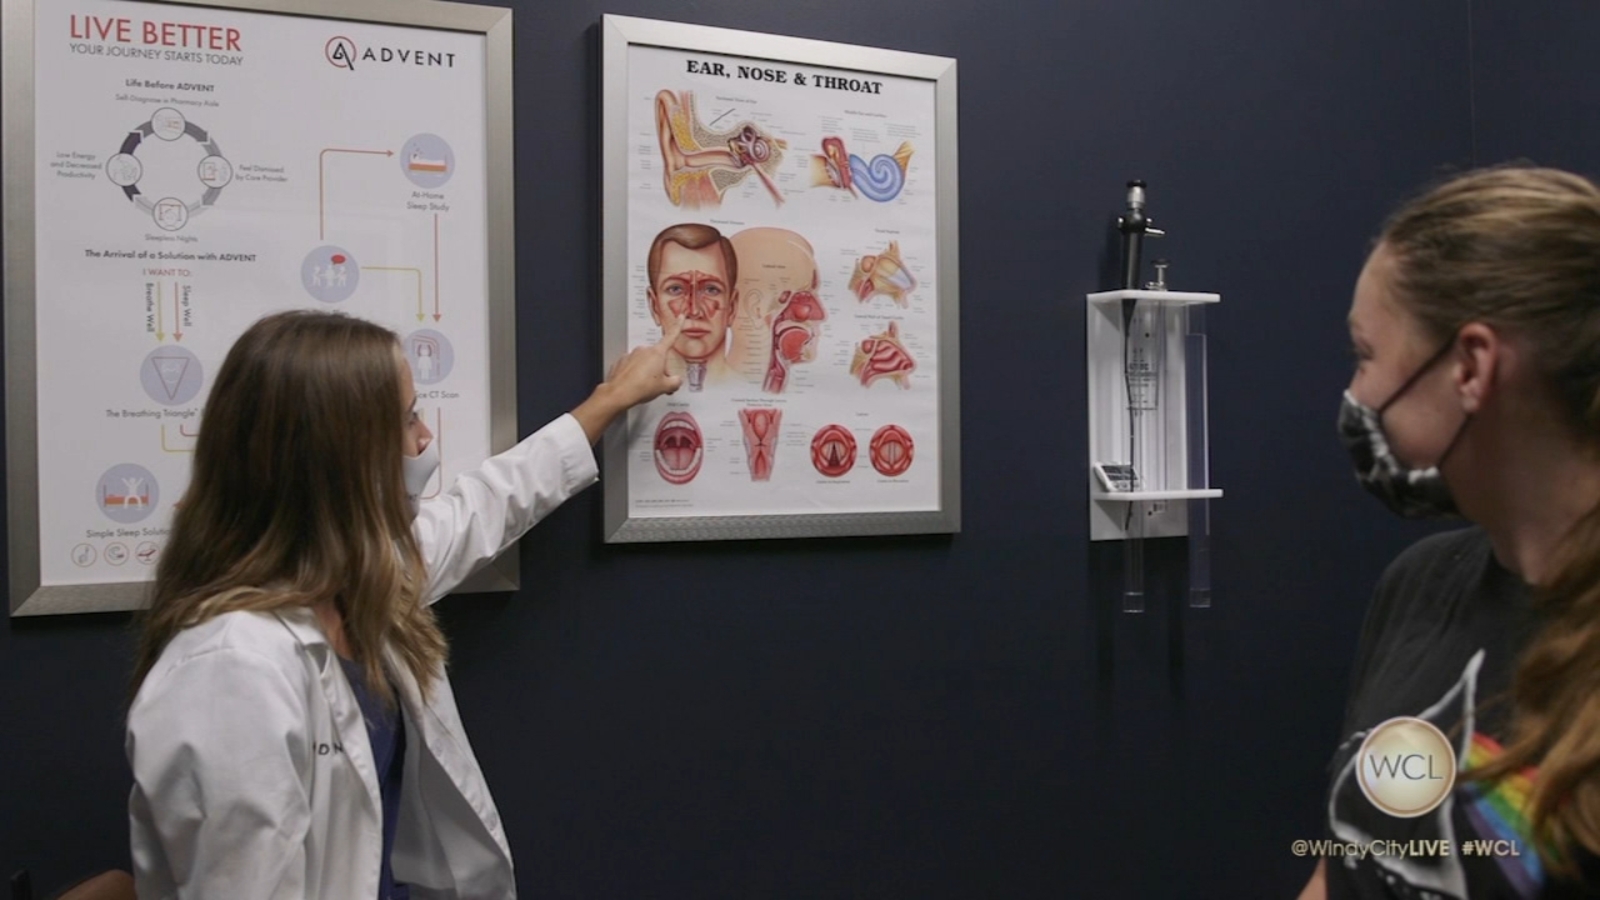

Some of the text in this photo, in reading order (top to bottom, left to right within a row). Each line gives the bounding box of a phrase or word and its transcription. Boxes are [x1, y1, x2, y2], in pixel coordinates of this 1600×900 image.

[70, 14, 242, 52] LIVE BETTER
[69, 43, 244, 66] YOUR JOURNEY STARTS TODAY
[362, 46, 456, 68] ADVENT
[125, 79, 215, 92] Life Before ADVENT
[686, 59, 883, 95] EAR, NOSE & THROAT
[85, 250, 101, 258] The
[103, 250, 136, 259] Arrival
[137, 250, 148, 259] of
[157, 251, 196, 260] Solution
[197, 252, 217, 261] with
[219, 253, 257, 262] ADVENT
[148, 268, 175, 276] WANT
[145, 282, 156, 332] Breathe Well
[182, 285, 192, 327] Sleep Well
[106, 409, 120, 417] The
[121, 409, 162, 419] Breathing
[86, 529, 114, 539] Simple
[116, 528, 140, 538] Sleep
